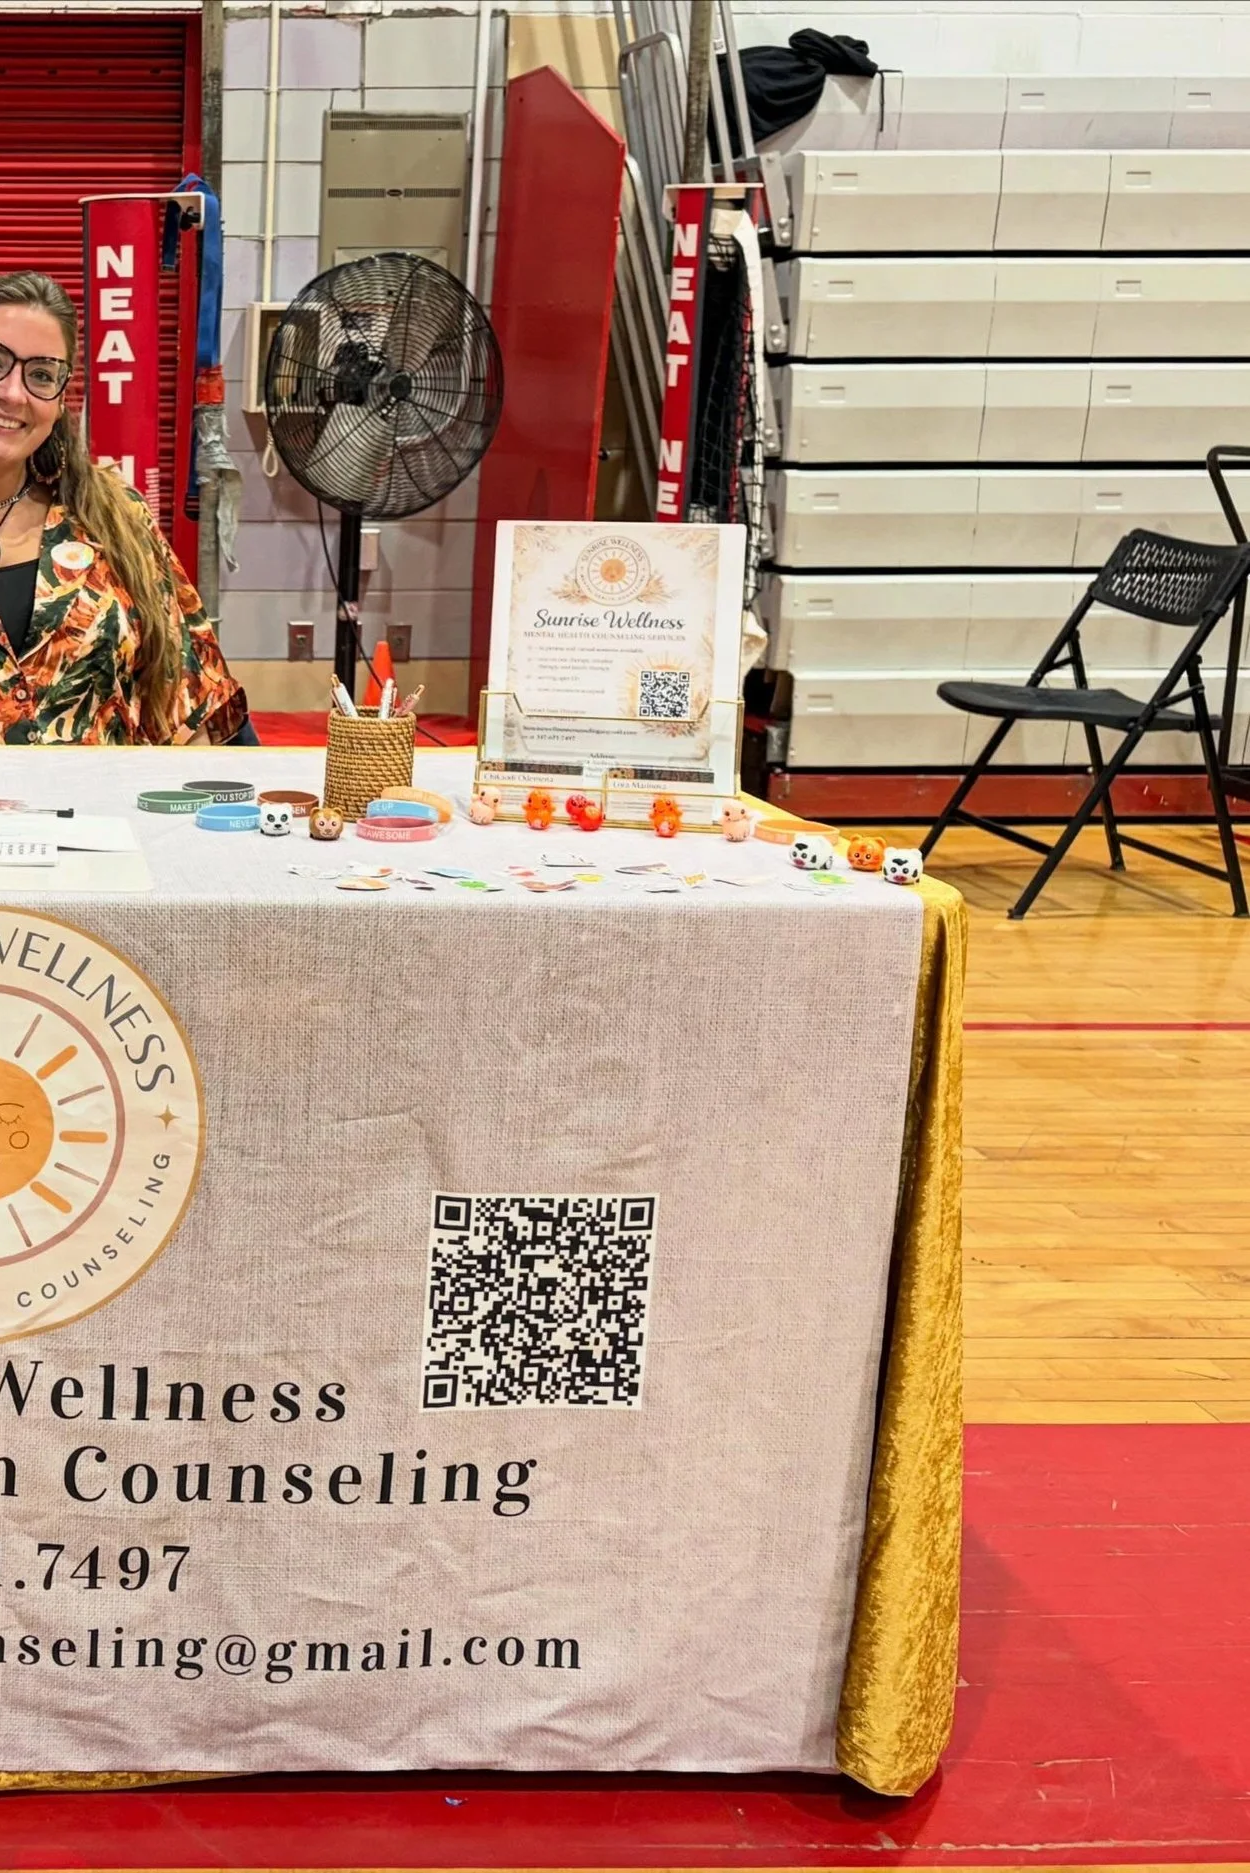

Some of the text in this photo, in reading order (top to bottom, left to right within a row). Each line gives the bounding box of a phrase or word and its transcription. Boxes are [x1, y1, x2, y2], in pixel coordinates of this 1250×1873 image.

[96, 245, 135, 404] NEAT
[656, 223, 698, 515] NEAT NE
[534, 608, 686, 630] Sunrise Wellness
[591, 632, 646, 640] COUNSELING
[647, 634, 687, 642] SERVICES
[170, 803, 193, 812] MAKE
[229, 792, 247, 802] STOP
[366, 830, 411, 840] AWESOME
[17, 1152, 171, 1308] COUNSELING
[63, 1445, 538, 1517] Counseling
